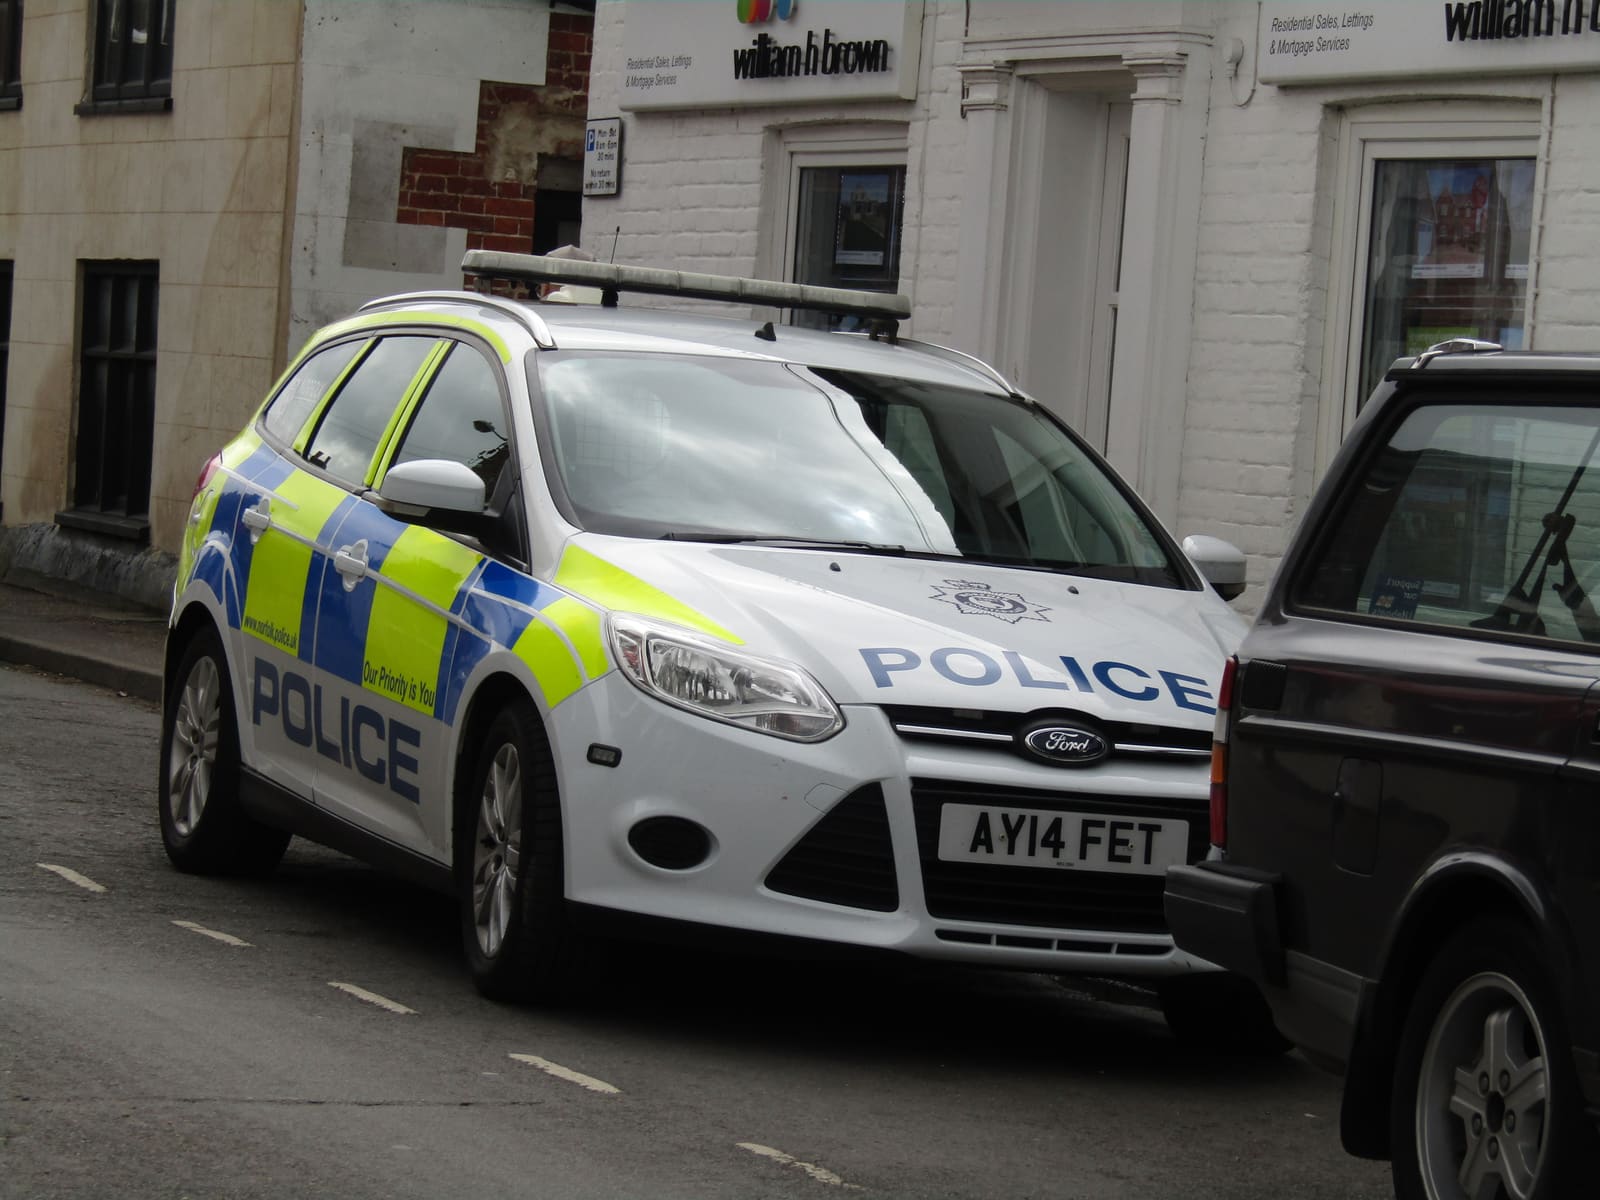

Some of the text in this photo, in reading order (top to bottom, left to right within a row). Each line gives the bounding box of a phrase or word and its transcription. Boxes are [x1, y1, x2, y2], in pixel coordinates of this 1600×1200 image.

[1271, 12, 1374, 32] Residential Sales, Lettings
[626, 57, 655, 70] Residential
[671, 55, 692, 70] Lettings
[733, 28, 889, 80] william h brown
[1269, 36, 1350, 56] & Mortgage Services
[631, 74, 655, 90] Mortgage
[655, 73, 677, 86] Services
[363, 661, 435, 707] Our Priority is You
[858, 647, 1216, 715] POLICE
[253, 656, 421, 804] POLICE
[1044, 732, 1091, 753] Ford
[969, 811, 1162, 865] AY14 FET
